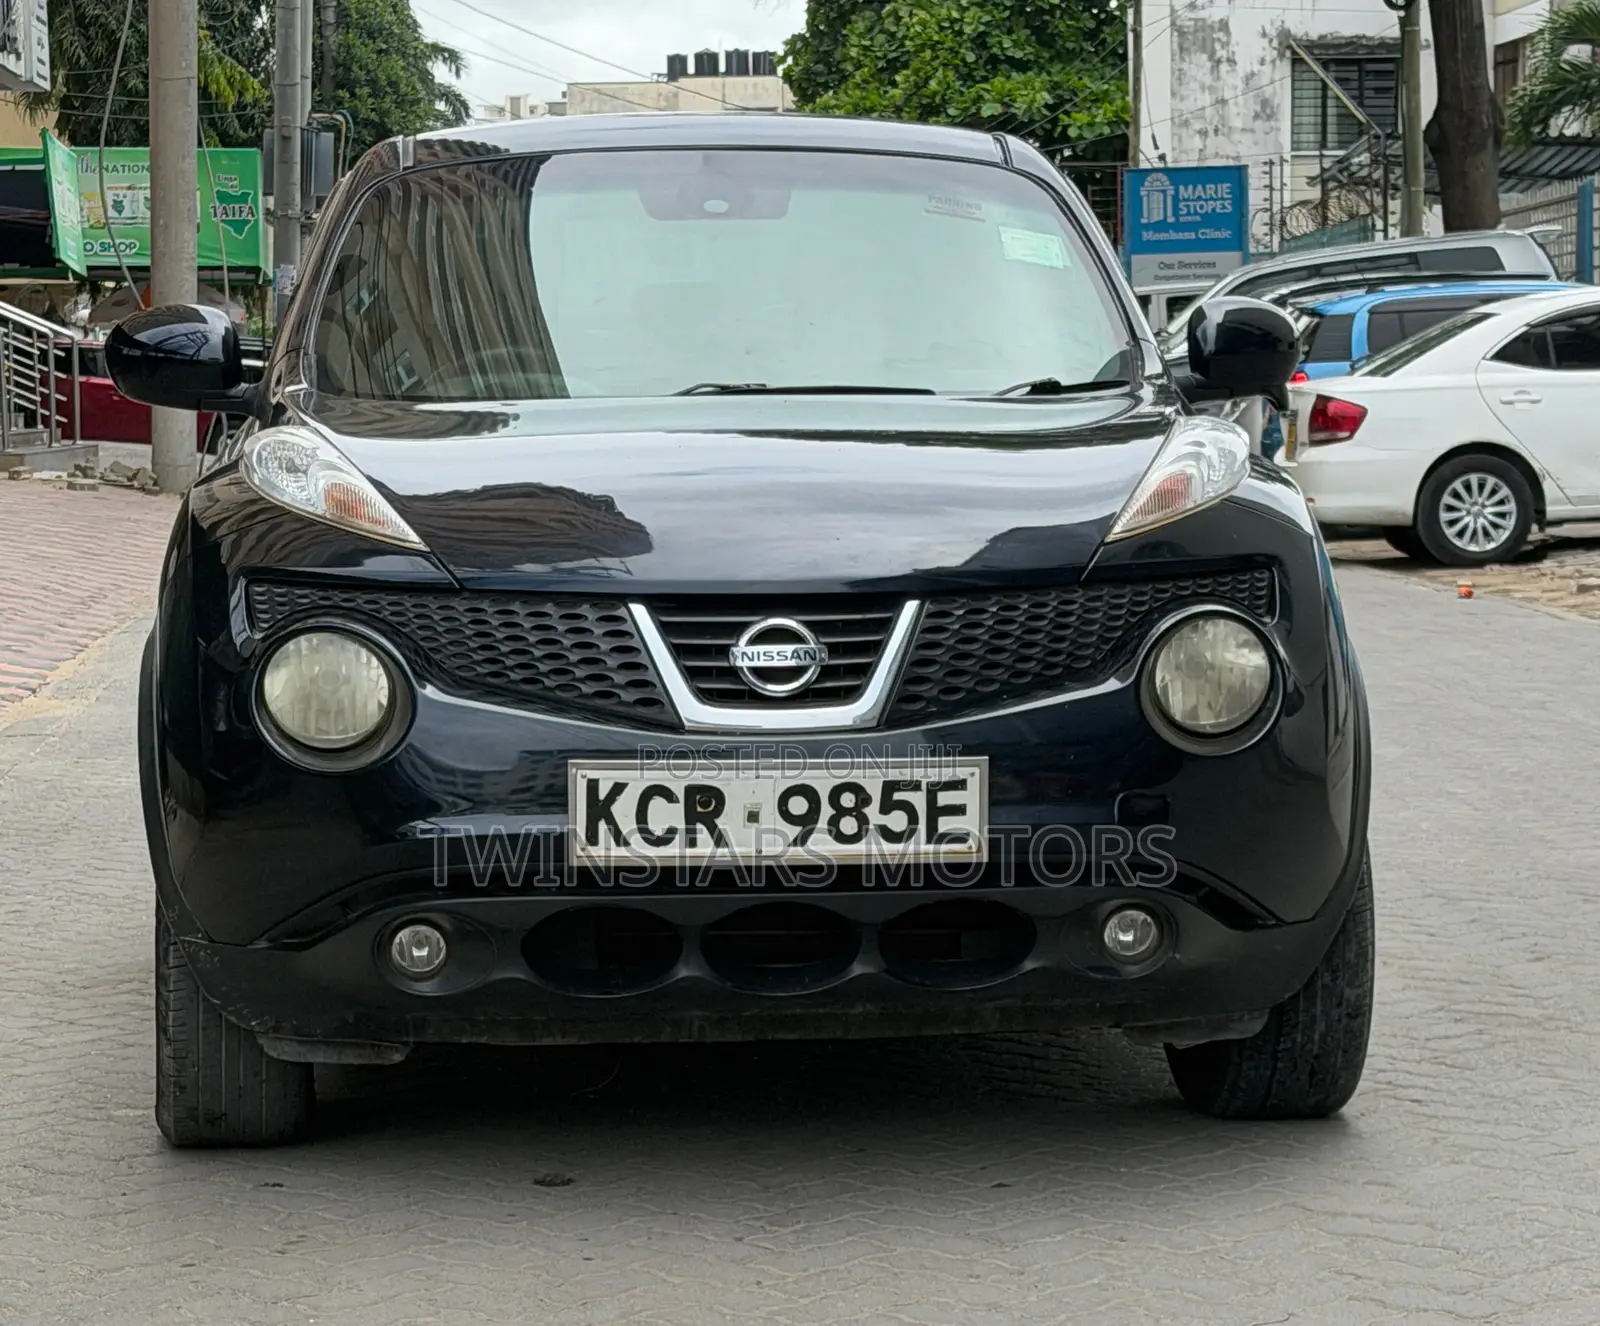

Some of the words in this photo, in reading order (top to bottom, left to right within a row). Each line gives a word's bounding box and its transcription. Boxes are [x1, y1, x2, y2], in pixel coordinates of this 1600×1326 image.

[1179, 183, 1232, 199] MARIE
[1179, 200, 1232, 214] STOPES
[1198, 228, 1233, 239] Clinic
[98, 240, 138, 254] SHOP
[740, 649, 818, 663] NISSAN
[585, 777, 727, 849] KCR
[776, 777, 970, 848] 985E
